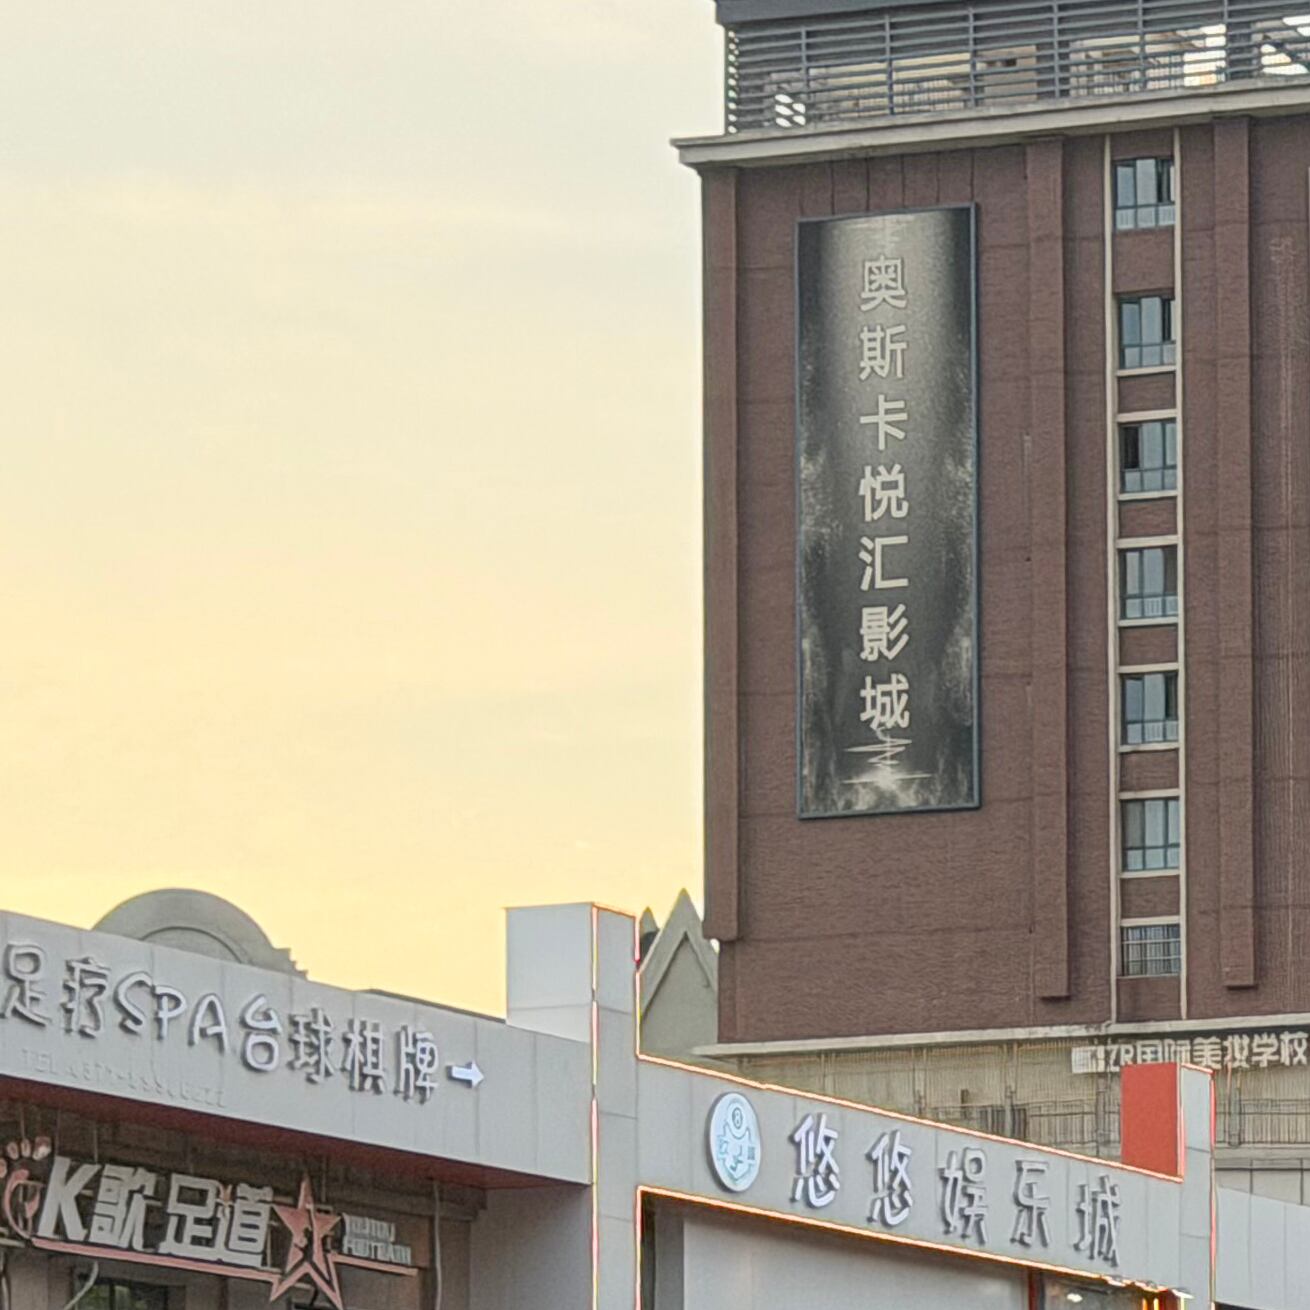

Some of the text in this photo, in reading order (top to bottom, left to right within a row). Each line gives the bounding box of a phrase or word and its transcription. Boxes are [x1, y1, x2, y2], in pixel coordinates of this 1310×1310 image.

[858, 254, 911, 729] 奥斯卡悦汇影城
[37, 1156, 274, 1268] K歌足道
[789, 1113, 1121, 1268] 悠悠娱乐城
